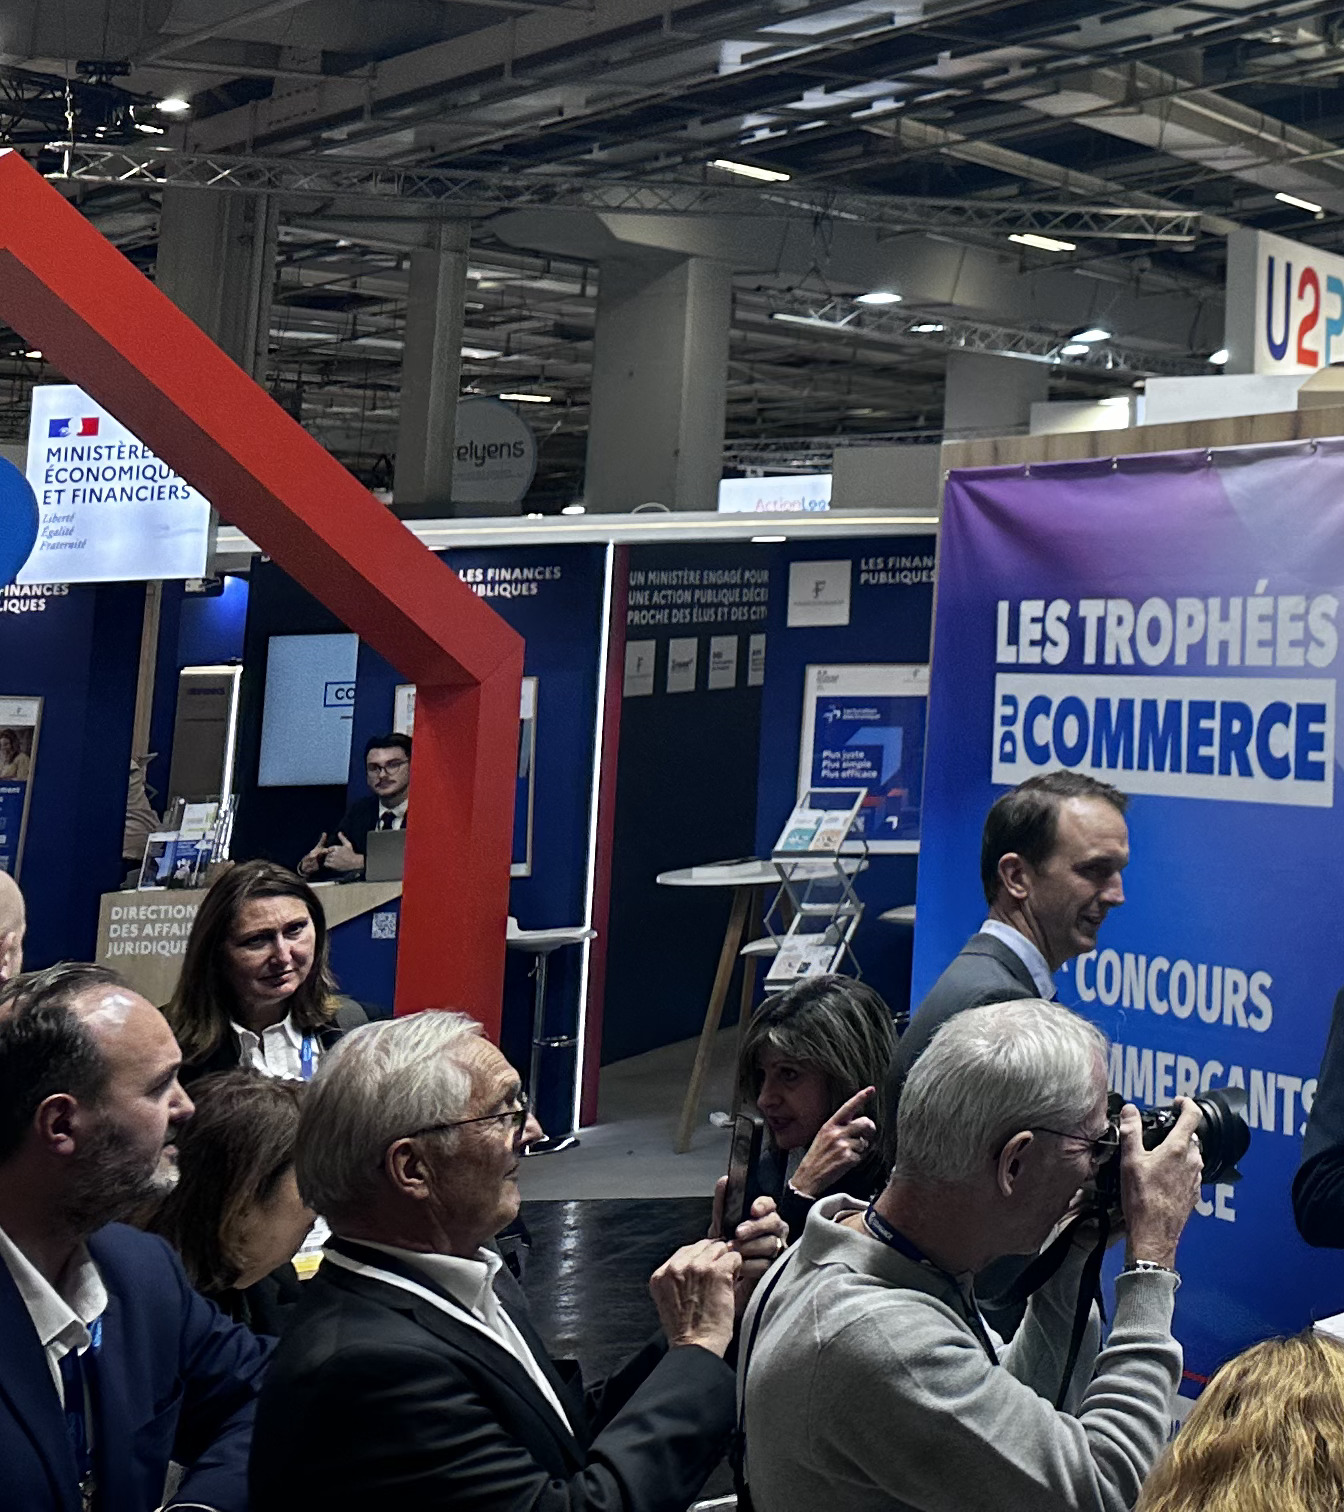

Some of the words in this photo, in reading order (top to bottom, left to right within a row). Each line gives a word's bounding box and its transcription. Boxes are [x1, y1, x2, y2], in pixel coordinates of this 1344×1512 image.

[46, 439, 156, 464] MINISTÈRE
[456, 439, 526, 468] elyens
[44, 463, 178, 485] ÉCONOMIQU
[42, 489, 66, 506] ET
[71, 484, 191, 505] FINANCIERS
[860, 556, 884, 571] LES
[459, 568, 484, 583] LES
[486, 566, 562, 582] FINANCES
[629, 569, 646, 586] UN
[647, 568, 701, 586] MINISTÈRE
[702, 567, 743, 585] ENGAGÉ
[628, 589, 650, 606] UNE
[652, 589, 693, 606] ACTION
[693, 587, 741, 606] PUBLIQUE
[626, 608, 670, 626] PROCHE
[671, 607, 691, 624] DES
[717, 605, 729, 622] ET
[730, 606, 750, 621] DES
[995, 599, 1072, 665] LES
[1078, 579, 1340, 669] TROPHÉES
[999, 694, 1017, 763] DU
[1023, 694, 1327, 782] COMMERCE
[111, 904, 199, 921] DIRECTION
[109, 923, 139, 939] DES
[1075, 948, 1274, 1033] CONCOURS
